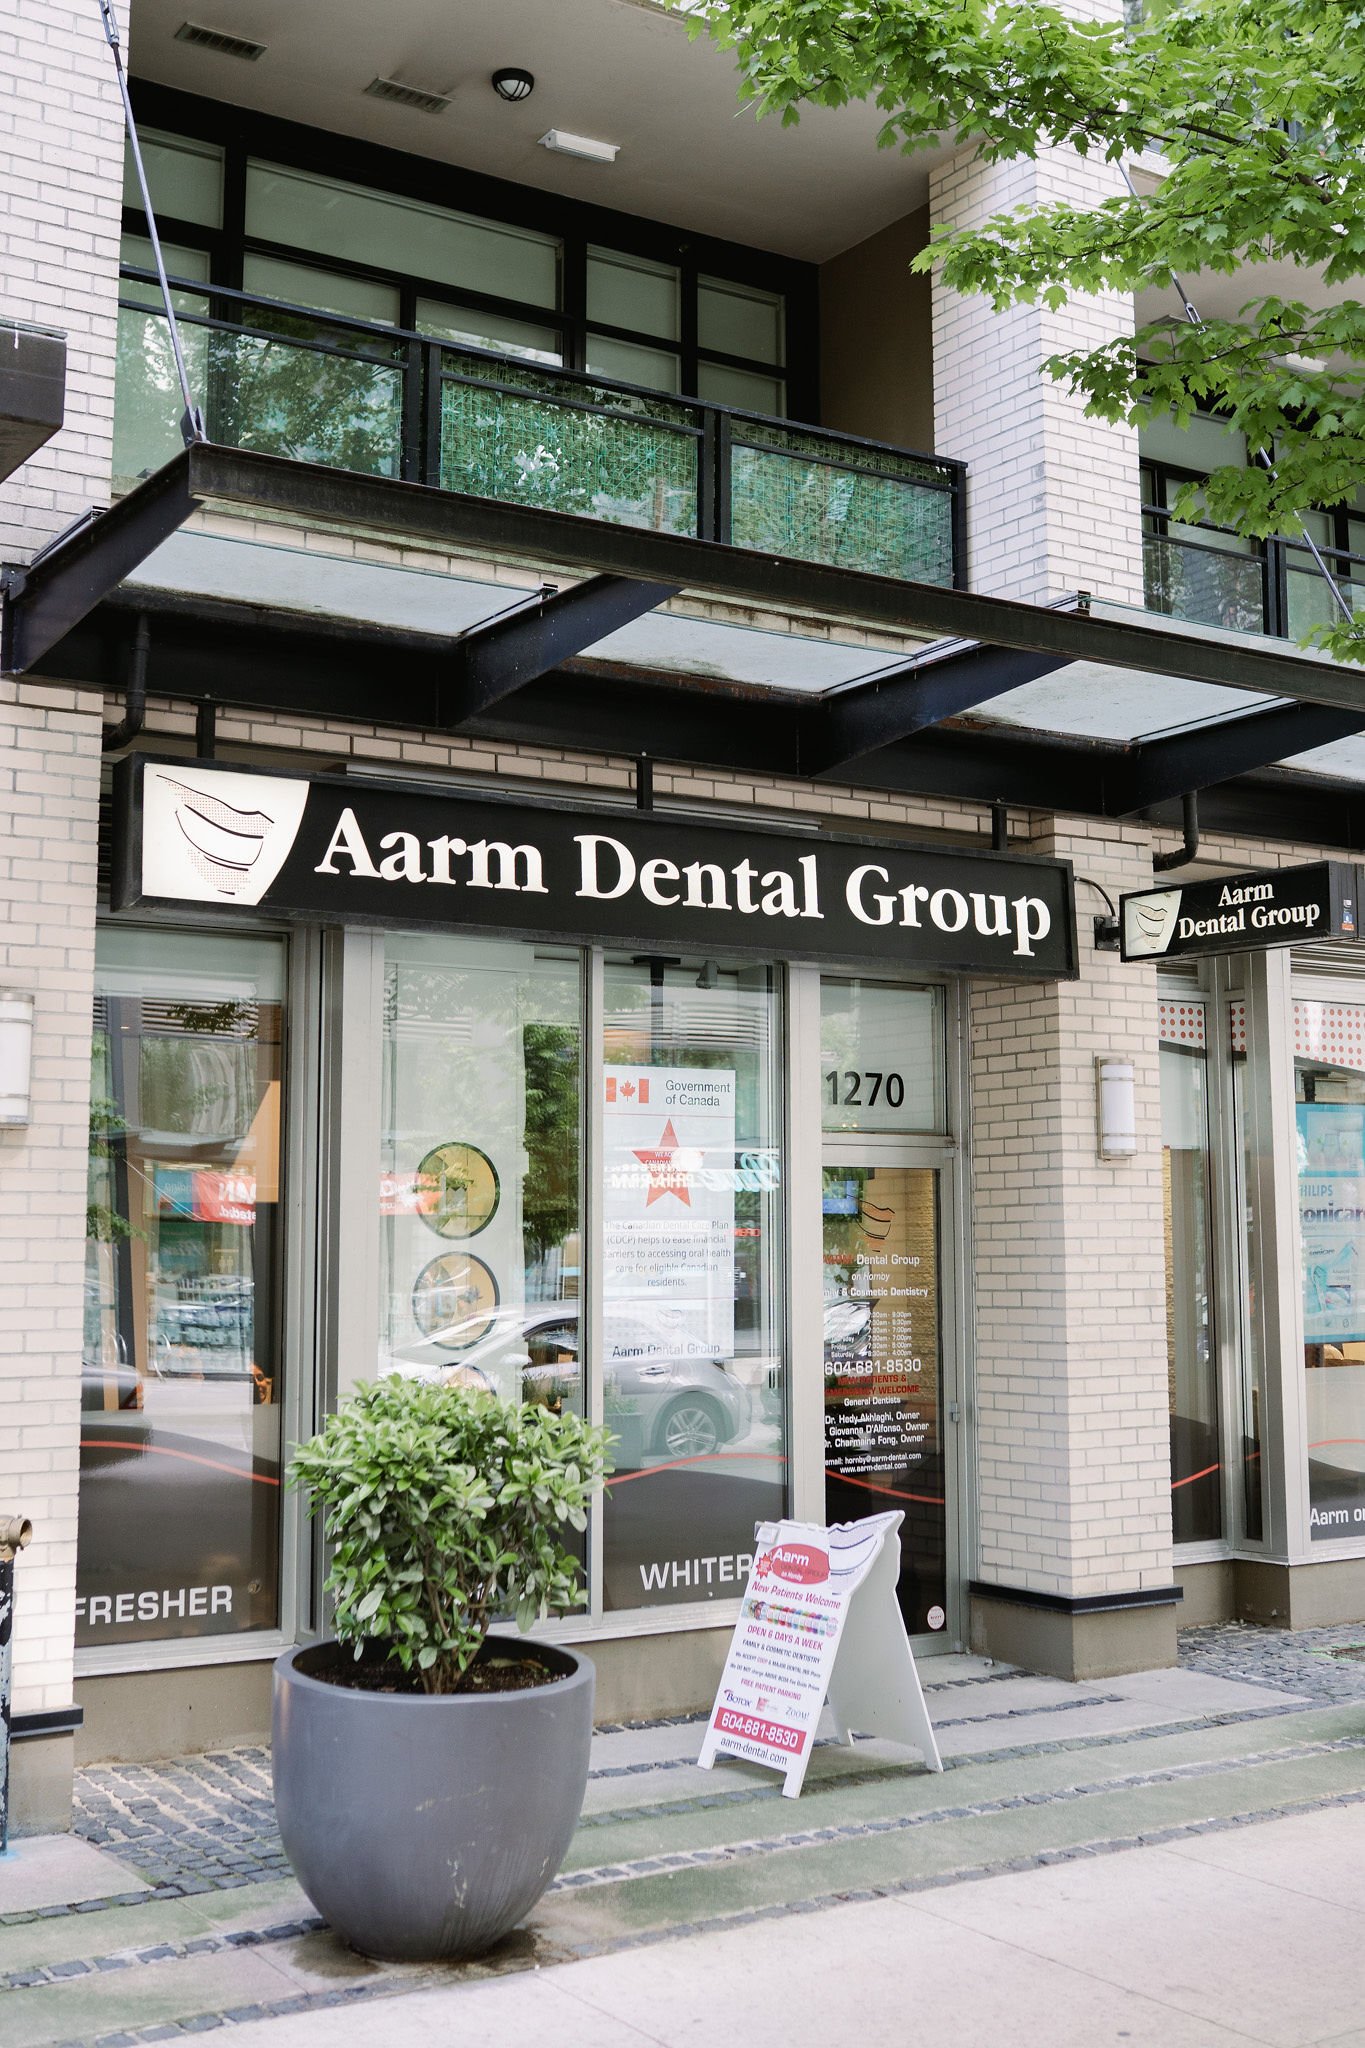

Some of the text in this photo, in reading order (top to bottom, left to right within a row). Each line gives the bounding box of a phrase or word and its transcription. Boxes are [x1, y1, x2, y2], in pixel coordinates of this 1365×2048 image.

[314, 807, 1051, 957] Aarm Dental Group
[1217, 883, 1274, 907] Aarm
[1178, 909, 1247, 939] Dental
[1251, 903, 1321, 928] Group
[665, 1079, 731, 1093] Government
[825, 1070, 905, 1108] 1270
[665, 1094, 721, 1107] of Canada
[711, 1220, 729, 1230] Plan
[637, 1236, 660, 1246] helps
[662, 1236, 671, 1245] to
[636, 1250, 646, 1258] to
[647, 1250, 687, 1261] accessing
[688, 1250, 705, 1258] oral
[856, 1253, 888, 1265] Dental
[891, 1253, 921, 1268] Group
[615, 1264, 634, 1273] care
[635, 1263, 647, 1272] for
[649, 1263, 679, 1275] eligible
[647, 1277, 688, 1287] residents.
[851, 1272, 890, 1282] on Hornby
[841, 1288, 848, 1297] &
[850, 1287, 888, 1298] Cosmetic
[890, 1286, 929, 1299] Dentistry
[612, 1345, 644, 1358] Aarm
[686, 1343, 721, 1356] Group
[824, 1358, 922, 1376] 604-681-8530
[878, 1385, 920, 1395] WELCOME
[843, 1395, 901, 1407] General Dentists
[824, 1415, 837, 1425] Dr.
[895, 1411, 920, 1420] Owner
[865, 1423, 903, 1434] D'Alfonso,
[905, 1422, 930, 1432] Owner
[834, 1436, 876, 1448] Charmaine
[877, 1434, 898, 1446] Fong,
[900, 1433, 925, 1443] Owner
[823, 1452, 922, 1466] email: hornby@aarm-dental.com
[839, 1461, 908, 1474] www.aarm-dental.com
[1310, 1507, 1365, 1526] Aarm o
[772, 1547, 810, 1567] Aarm
[639, 1553, 753, 1591] WHITER
[751, 1580, 842, 1610] New Patients Welcome
[75, 1584, 233, 1626] FRESHER
[747, 1624, 824, 1652] OPEN 6 DAYS A WEEK
[742, 1638, 760, 1649] FAMILY
[766, 1645, 792, 1658] COSMETIC
[792, 1651, 821, 1665] DENTISTRY
[740, 1677, 802, 1701] FREE PATIENT PARKING
[721, 1711, 799, 1748] 604-681-8530
[719, 1736, 788, 1765] aarm-dental.com
